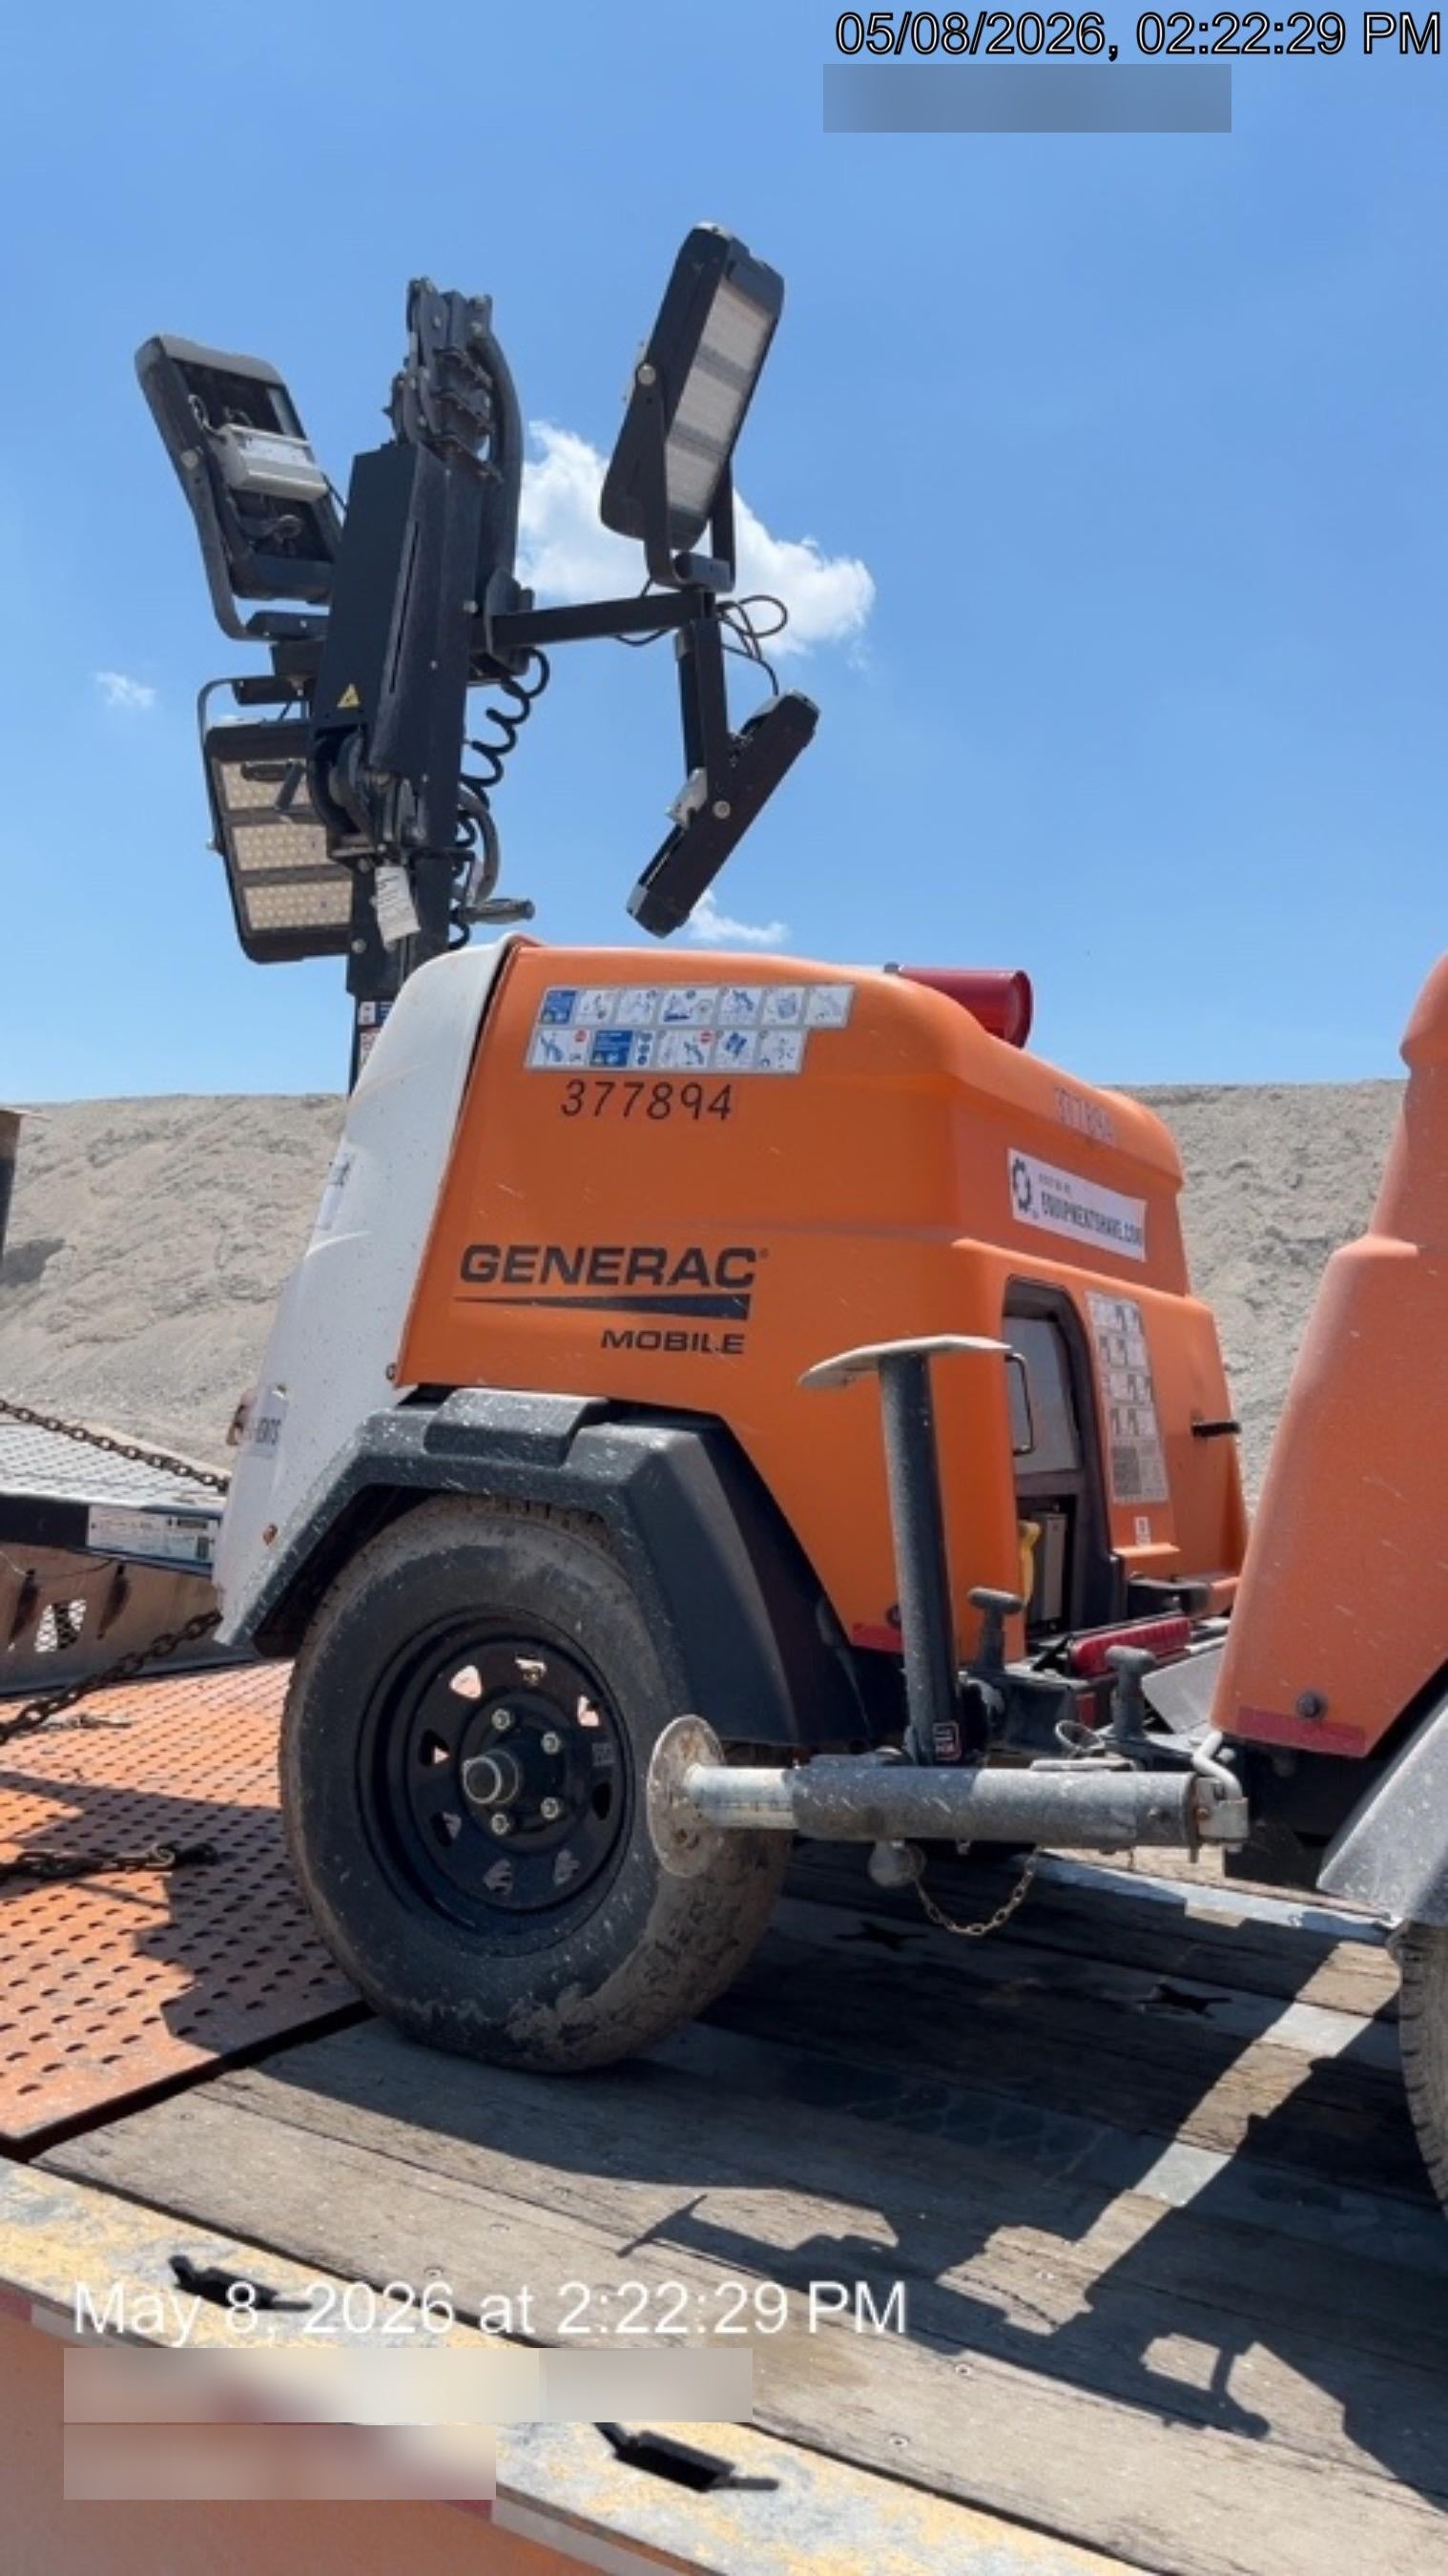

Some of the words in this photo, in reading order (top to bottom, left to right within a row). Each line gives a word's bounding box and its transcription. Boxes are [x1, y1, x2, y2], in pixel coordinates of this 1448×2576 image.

[560, 1078, 733, 1120] 377894
[460, 1243, 756, 1289] GENERAC
[600, 1329, 745, 1355] MOBILE
